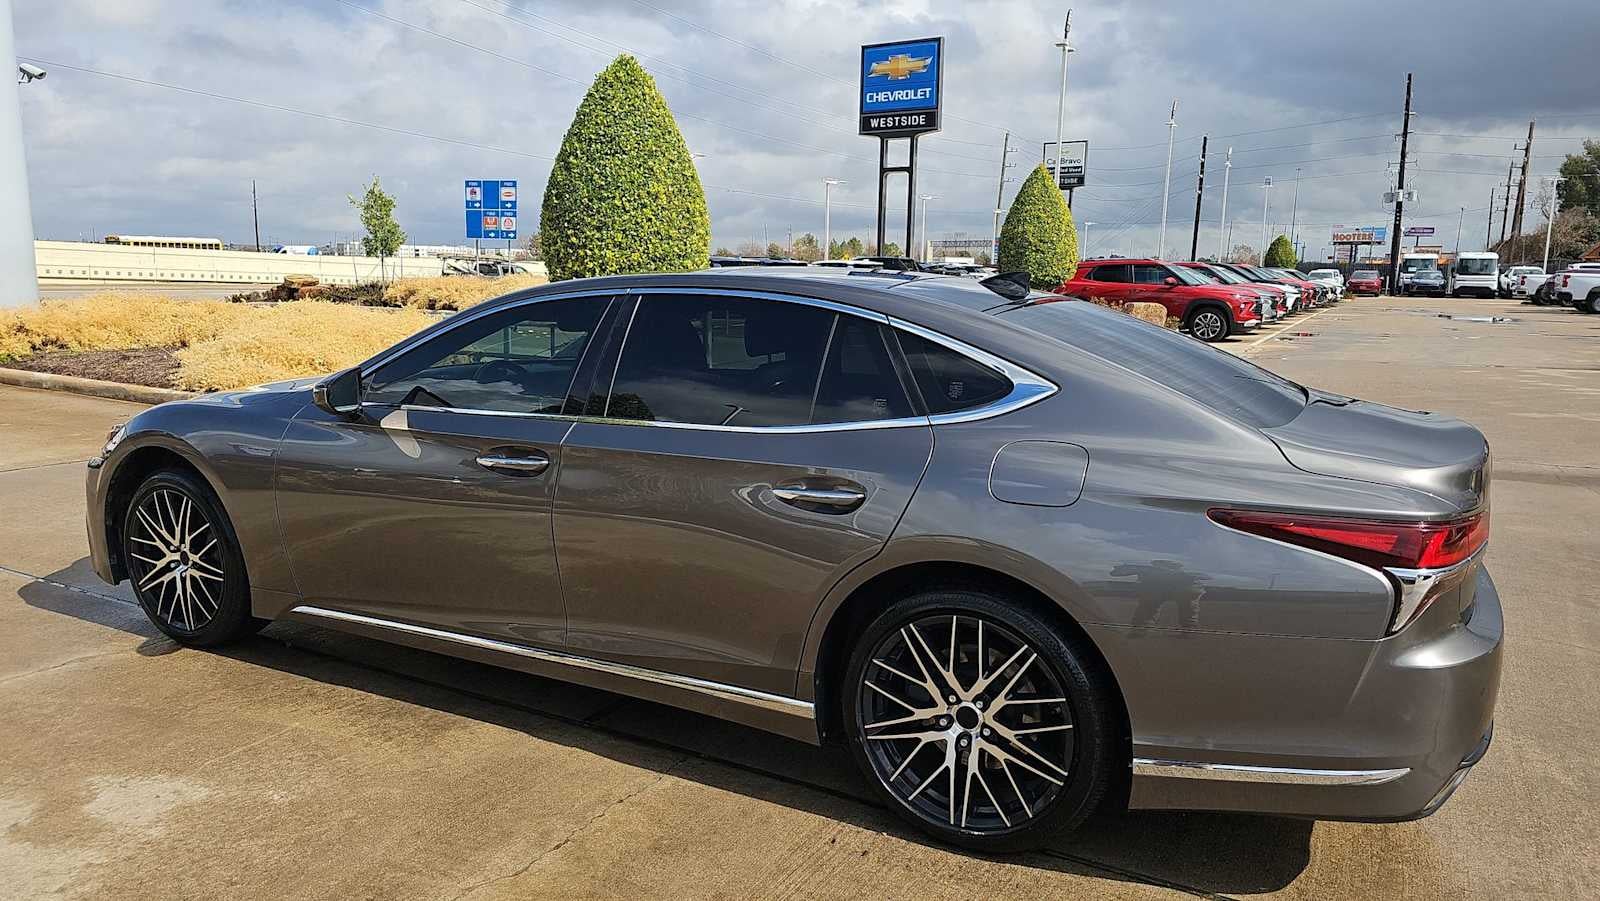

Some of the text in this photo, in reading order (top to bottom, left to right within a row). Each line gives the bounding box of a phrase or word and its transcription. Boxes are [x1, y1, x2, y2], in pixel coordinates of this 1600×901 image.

[866, 88, 932, 103] CHEVROLET
[870, 115, 926, 128] WESTSIDE
[1046, 157, 1082, 165] CaBravo
[1332, 232, 1373, 241] HOOTERS
